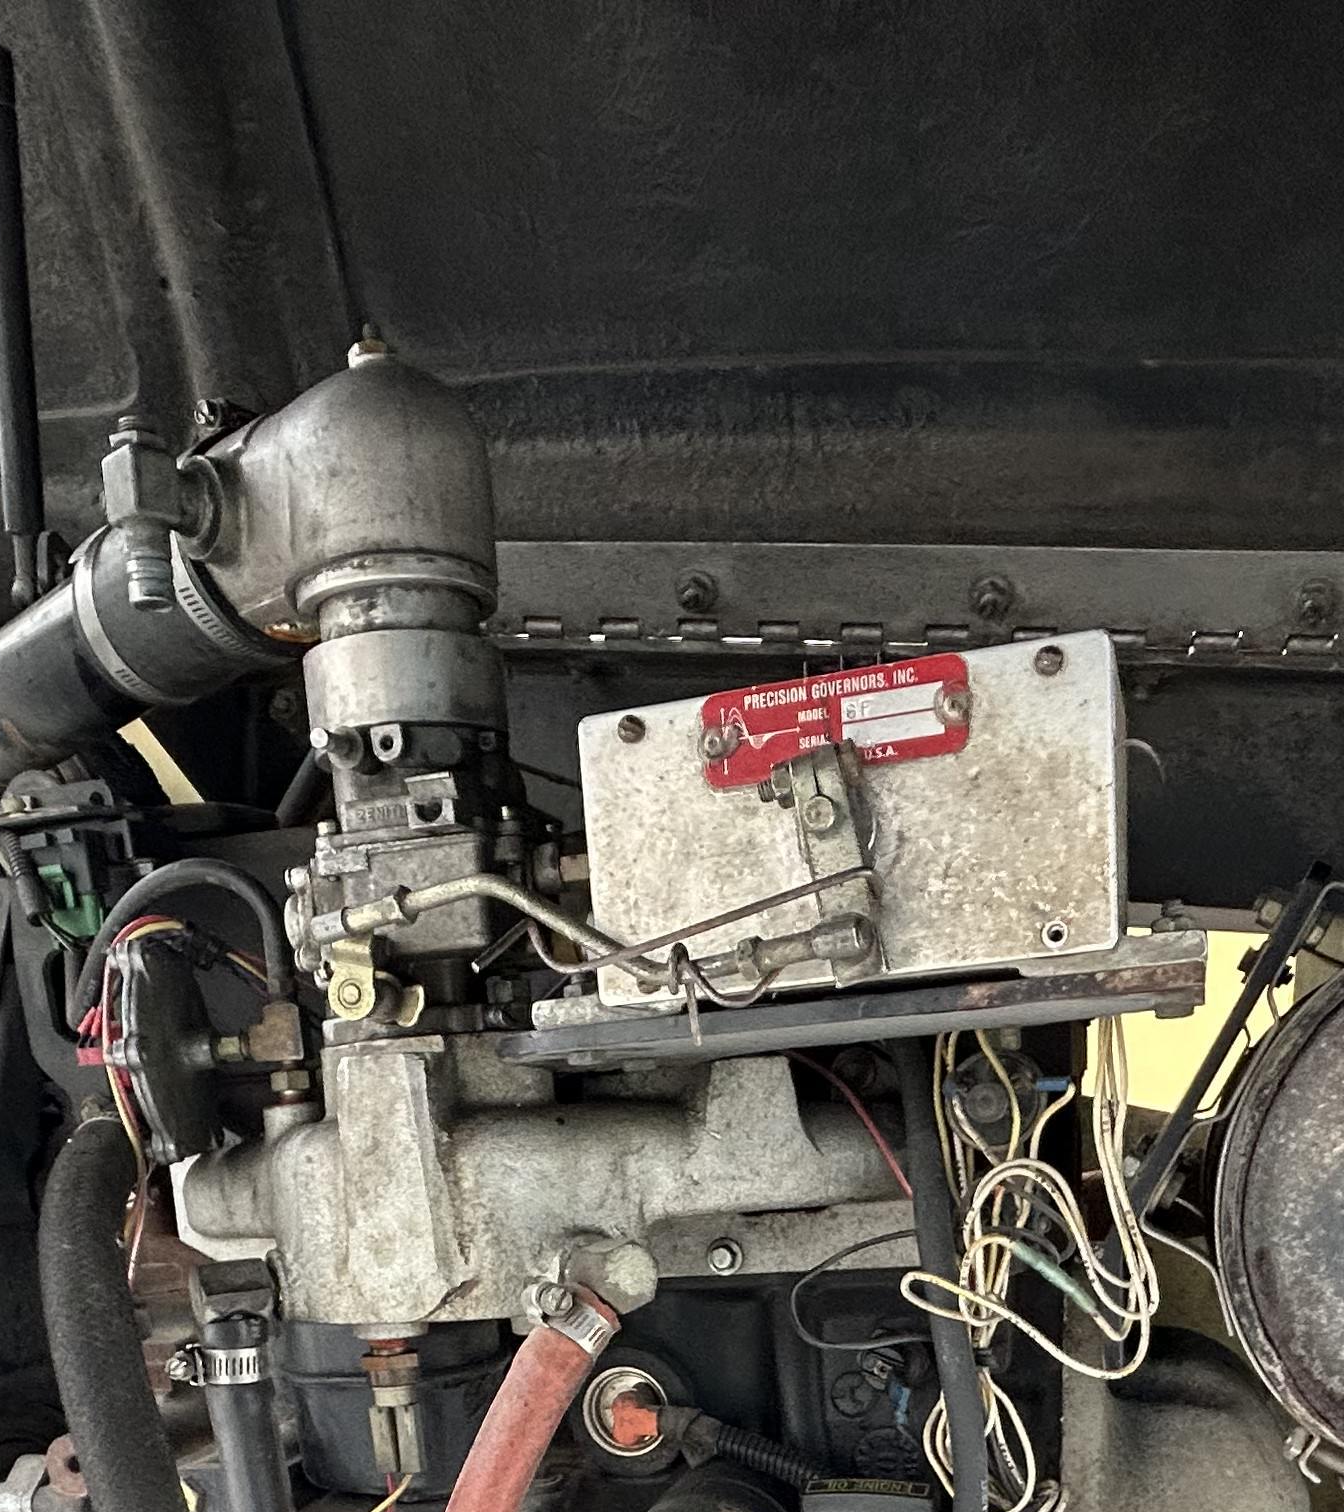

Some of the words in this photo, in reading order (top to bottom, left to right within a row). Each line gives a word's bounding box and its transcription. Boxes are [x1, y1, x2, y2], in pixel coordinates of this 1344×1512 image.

[743, 686, 807, 711] PRECISION
[893, 666, 918, 684] INC.
[797, 708, 830, 723] MODEL
